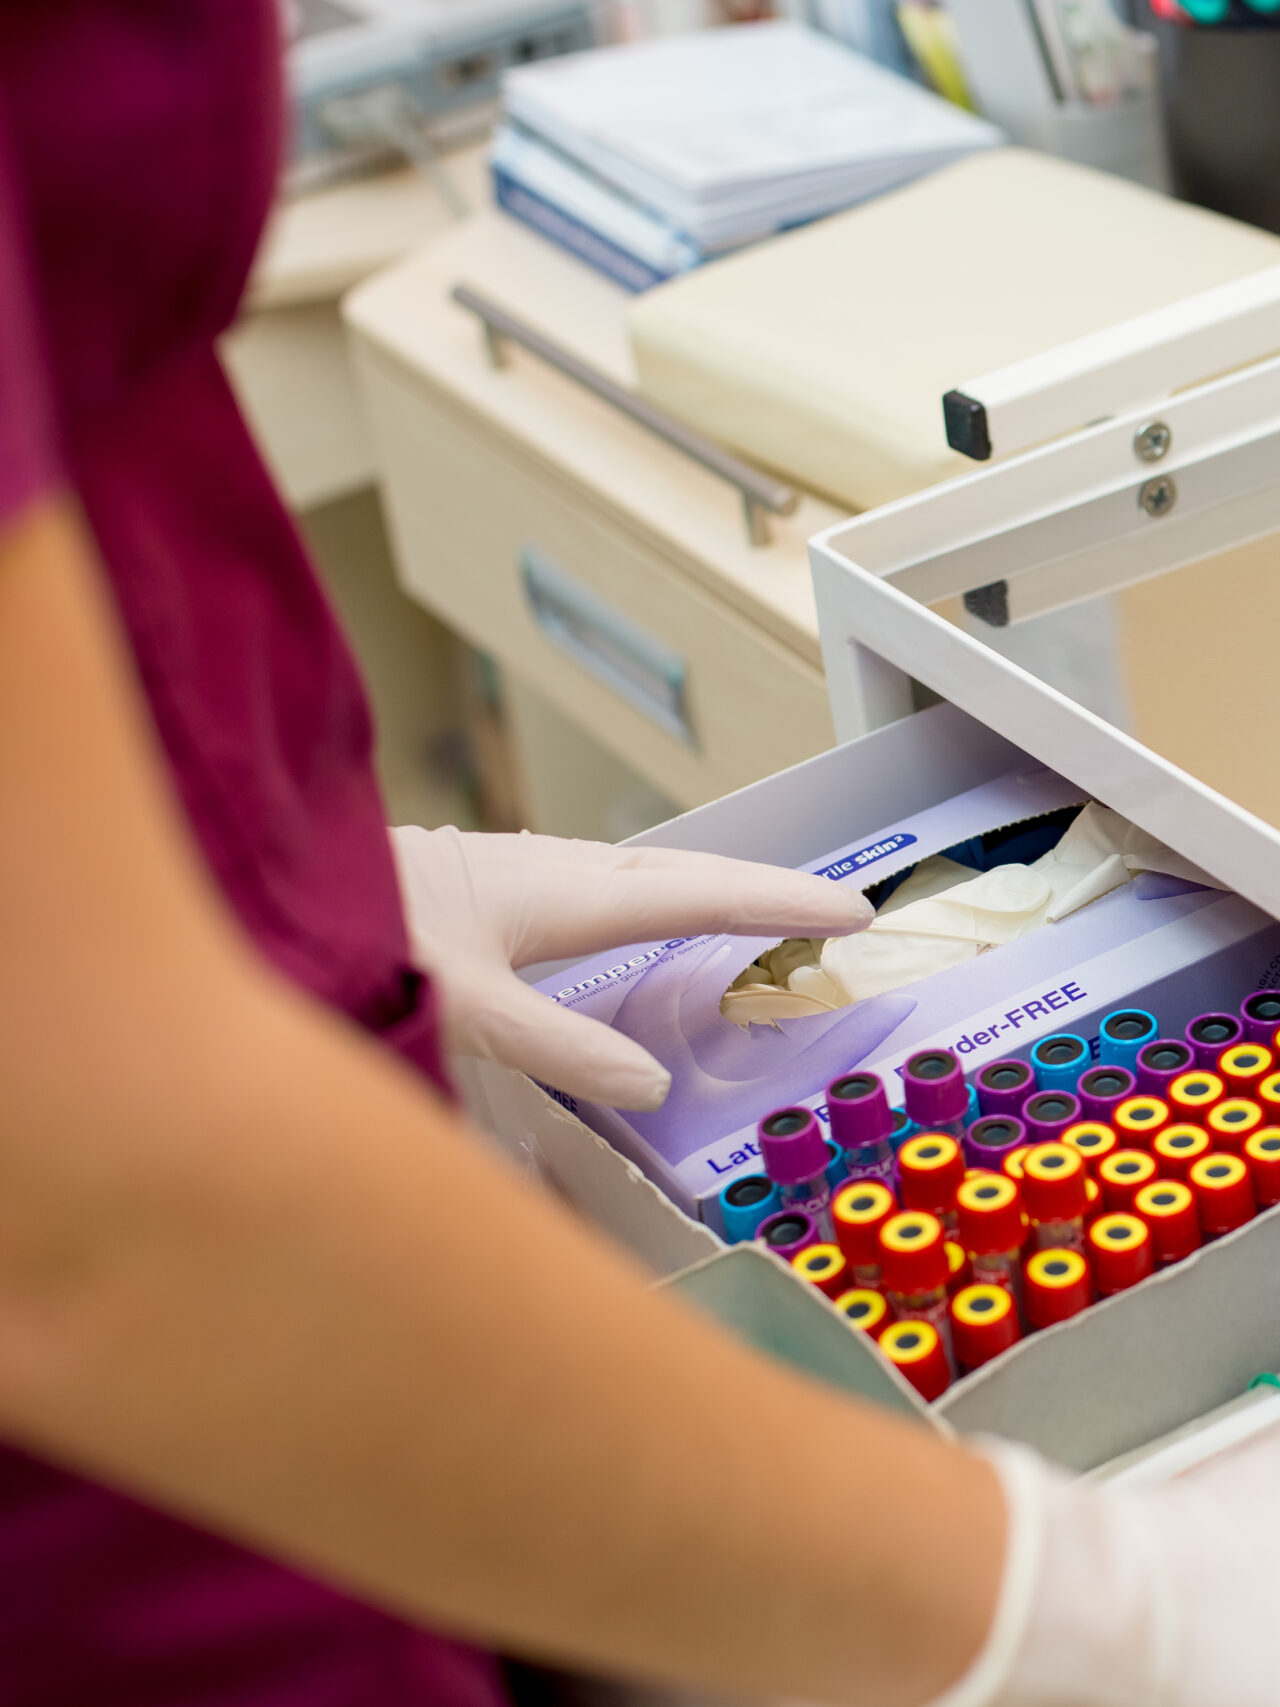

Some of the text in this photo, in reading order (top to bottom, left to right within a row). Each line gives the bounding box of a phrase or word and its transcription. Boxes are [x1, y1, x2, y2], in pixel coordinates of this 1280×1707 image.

[564, 979, 619, 1008] mination
[660, 953, 675, 965] by
[707, 1142, 762, 1174] Lat
